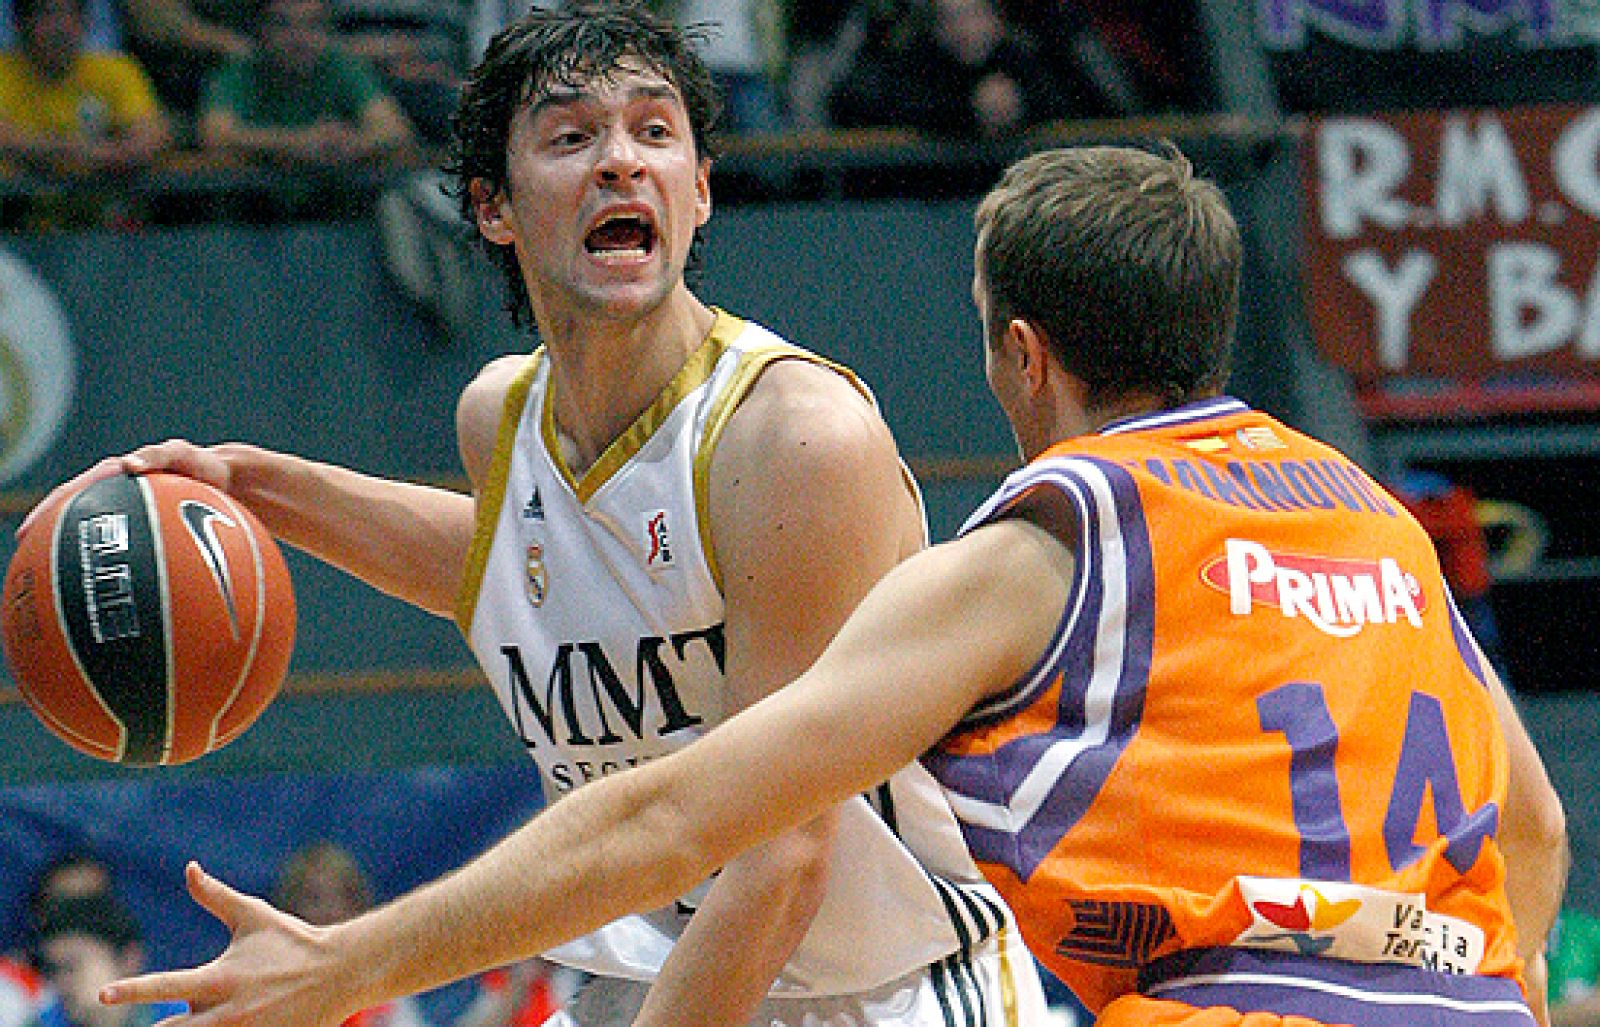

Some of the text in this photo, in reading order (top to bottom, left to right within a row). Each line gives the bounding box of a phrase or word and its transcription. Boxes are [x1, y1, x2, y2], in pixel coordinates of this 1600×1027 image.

[1343, 246, 1440, 370] Y
[1224, 537, 1424, 638] PRIMA
[499, 622, 726, 748] MMT
[1255, 681, 1500, 884] 14
